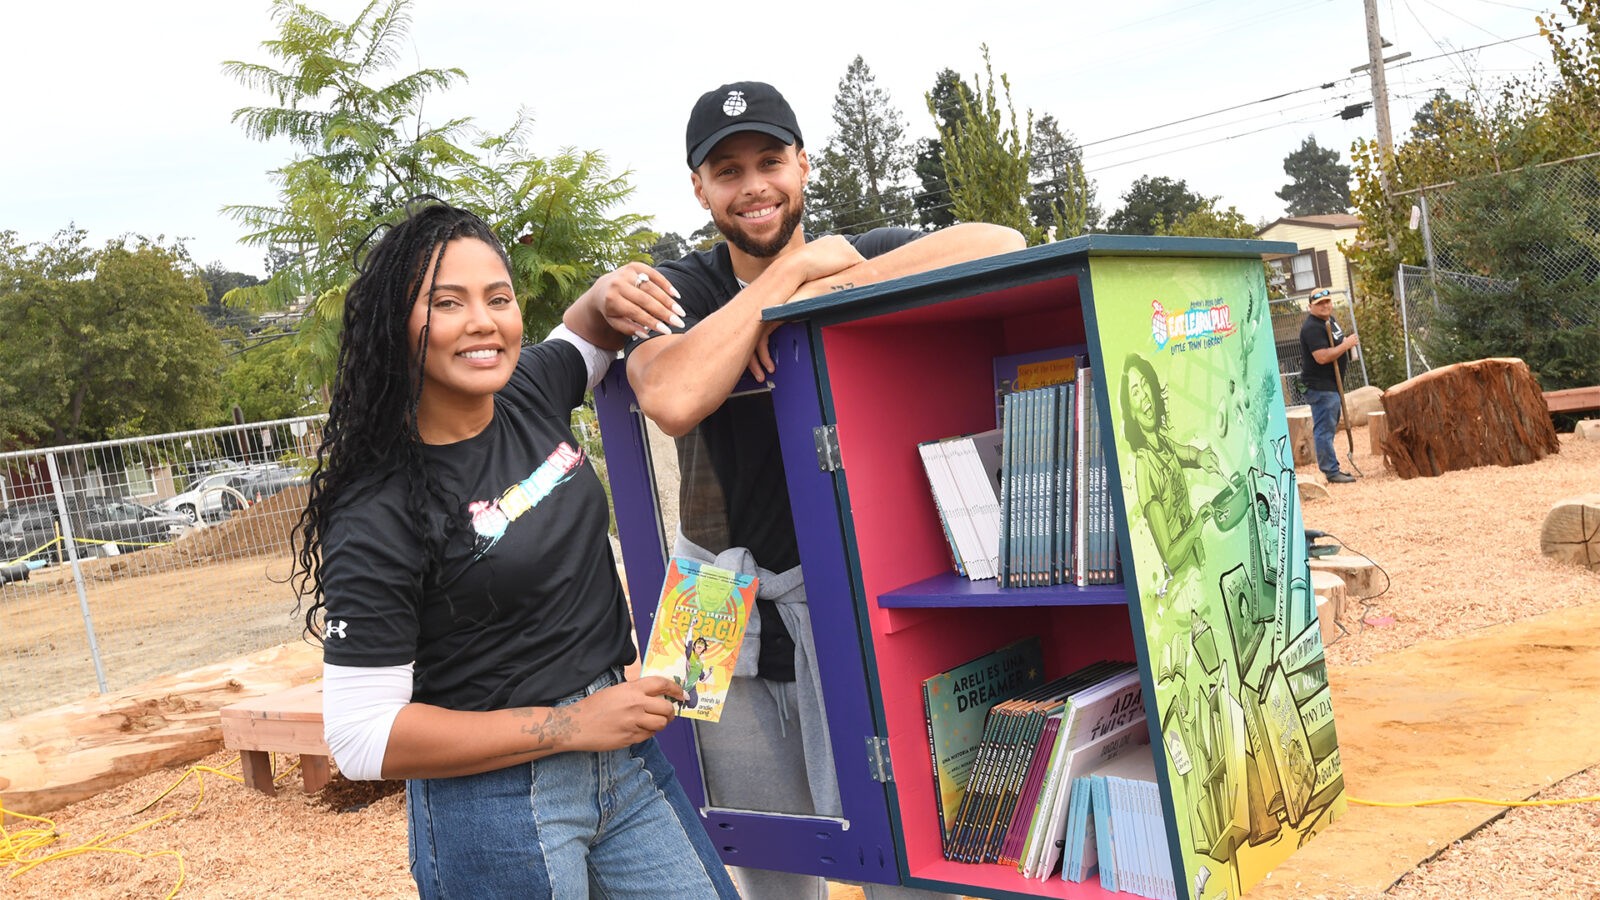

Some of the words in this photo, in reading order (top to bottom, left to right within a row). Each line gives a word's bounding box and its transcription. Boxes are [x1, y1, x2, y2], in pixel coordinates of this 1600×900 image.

[1170, 343, 1186, 355] LITTLE
[1188, 339, 1202, 351] TOWN
[1203, 335, 1225, 349] LIBRARY
[1278, 523, 1289, 581] Sidewalk
[665, 602, 741, 649] Legacy
[1276, 595, 1285, 642] Where
[953, 669, 985, 695] ARELI
[987, 663, 1000, 677] ES
[1002, 653, 1024, 673] UNA
[956, 670, 1024, 713] DREAMER
[1091, 704, 1146, 741] TWIST'
[1110, 688, 1142, 717] ADA
